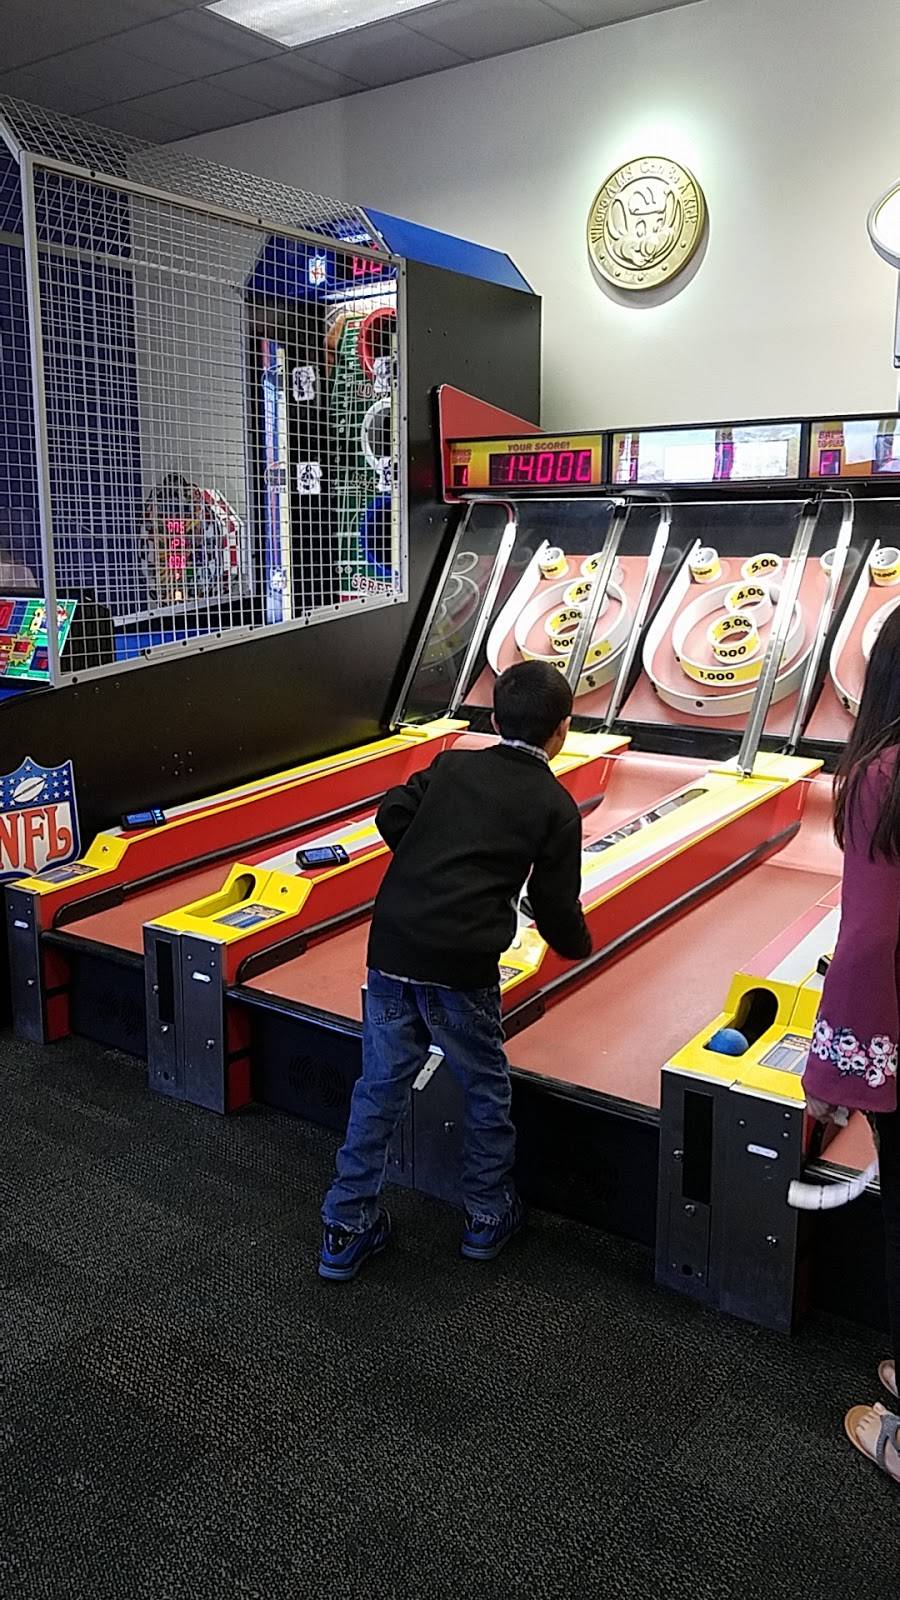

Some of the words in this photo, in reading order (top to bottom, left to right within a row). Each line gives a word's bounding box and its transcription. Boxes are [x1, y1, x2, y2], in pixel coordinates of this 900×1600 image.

[507, 443, 531, 452] YOUR
[534, 441, 570, 450] SCORE!
[699, 670, 735, 681] 1,000
[0, 807, 72, 873] NFL
